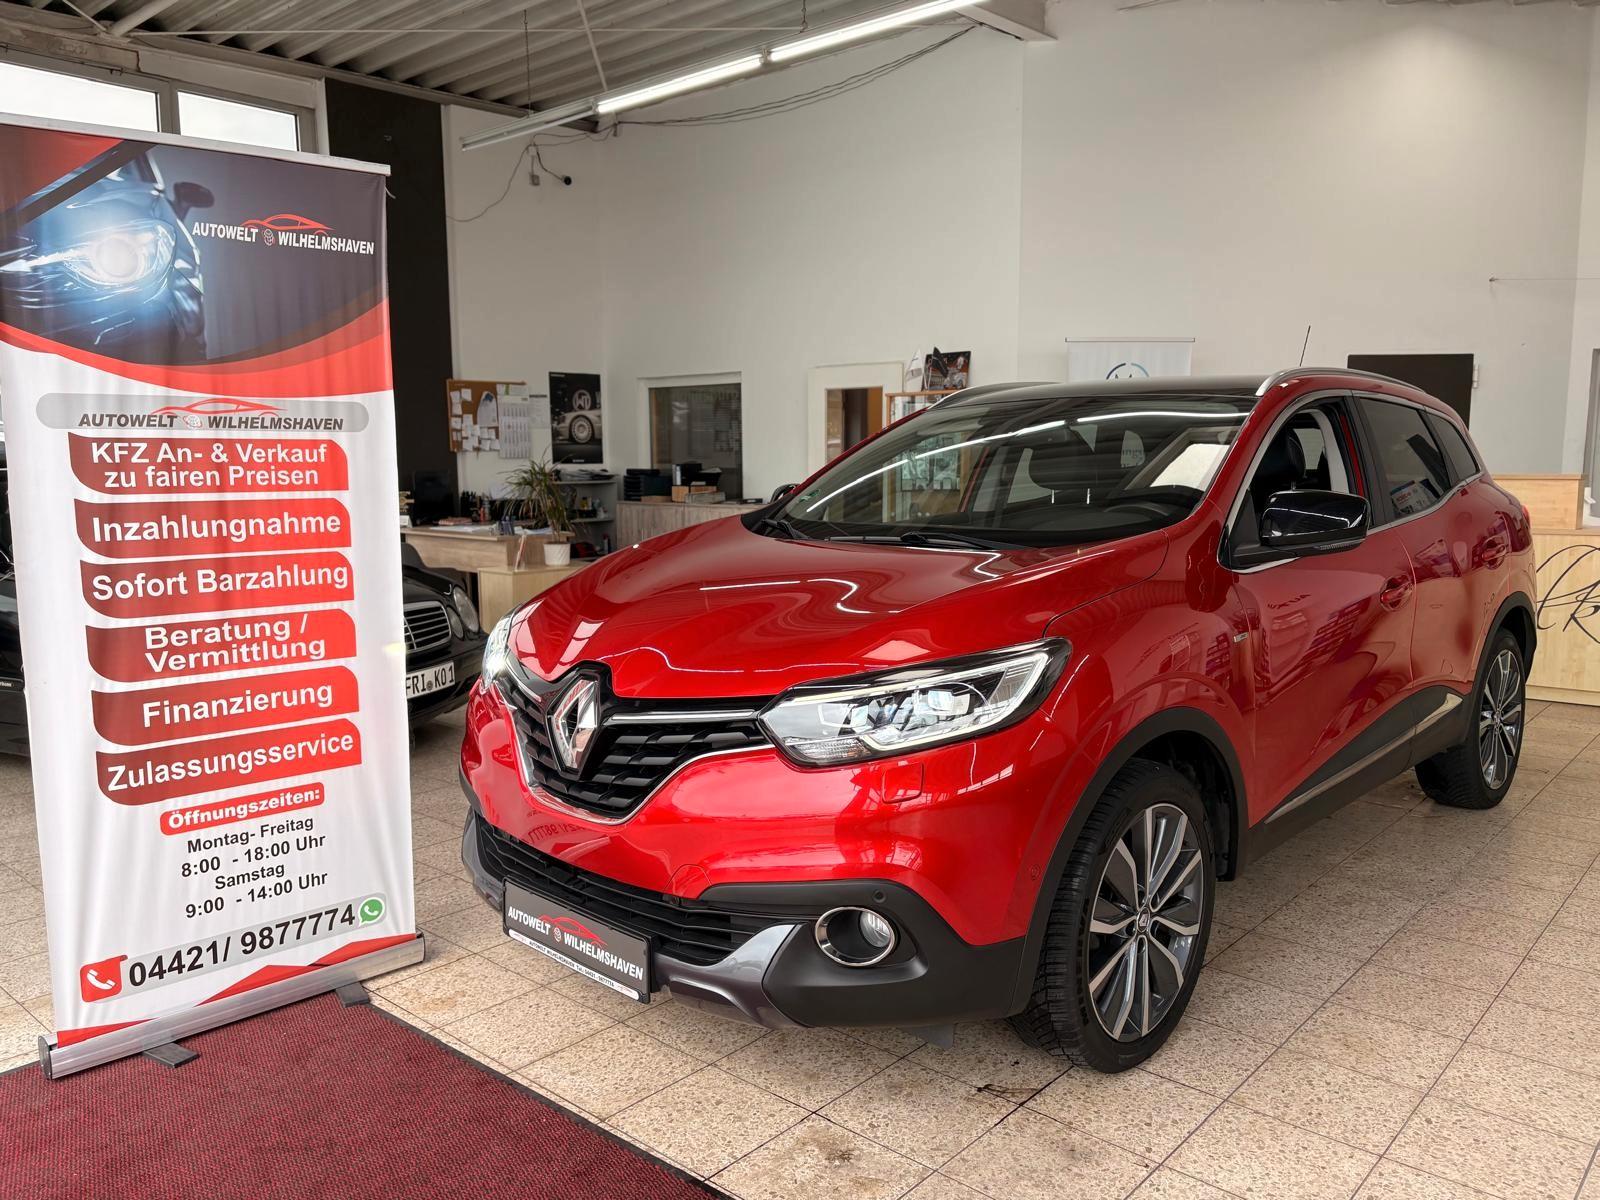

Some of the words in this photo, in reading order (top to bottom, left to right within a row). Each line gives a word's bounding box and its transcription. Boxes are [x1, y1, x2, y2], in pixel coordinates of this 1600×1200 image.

[192, 222, 259, 242] AUTOWELT
[278, 231, 375, 255] WILHELMSHAVEN
[78, 413, 178, 428] AUTOWELT
[208, 416, 343, 431] WILHELMSHAVEN
[91, 442, 150, 464] KFZ
[156, 442, 202, 463] An-
[211, 444, 229, 462] &
[236, 443, 327, 463] Verkauf
[104, 471, 136, 488] zu
[146, 466, 220, 487] fairen
[229, 466, 318, 486] Preisen
[92, 511, 341, 542] Inzahlungnahme
[92, 572, 188, 601] Sofort
[197, 563, 348, 594] Barzahlung
[144, 618, 290, 650] Beratung
[145, 638, 326, 673] Vermittlung
[143, 684, 333, 728] Finanzierung
[107, 733, 353, 791] Zulassungsservice
[168, 788, 320, 829] Öffnungszeiten:
[187, 829, 256, 854] Montag-
[260, 817, 314, 838] Freitag
[181, 856, 221, 878] 8:00
[244, 841, 290, 863] 18:00
[296, 834, 326, 852] Uhr
[185, 897, 225, 918] 9:00
[247, 880, 293, 902] 14:00
[298, 872, 328, 890] Uhr
[215, 864, 285, 890] Samstag
[129, 937, 231, 987] 04421/
[241, 904, 355, 956] 9877774
[508, 906, 551, 935] AUTOWELT
[564, 932, 643, 980] WILHELMSHAVEN
